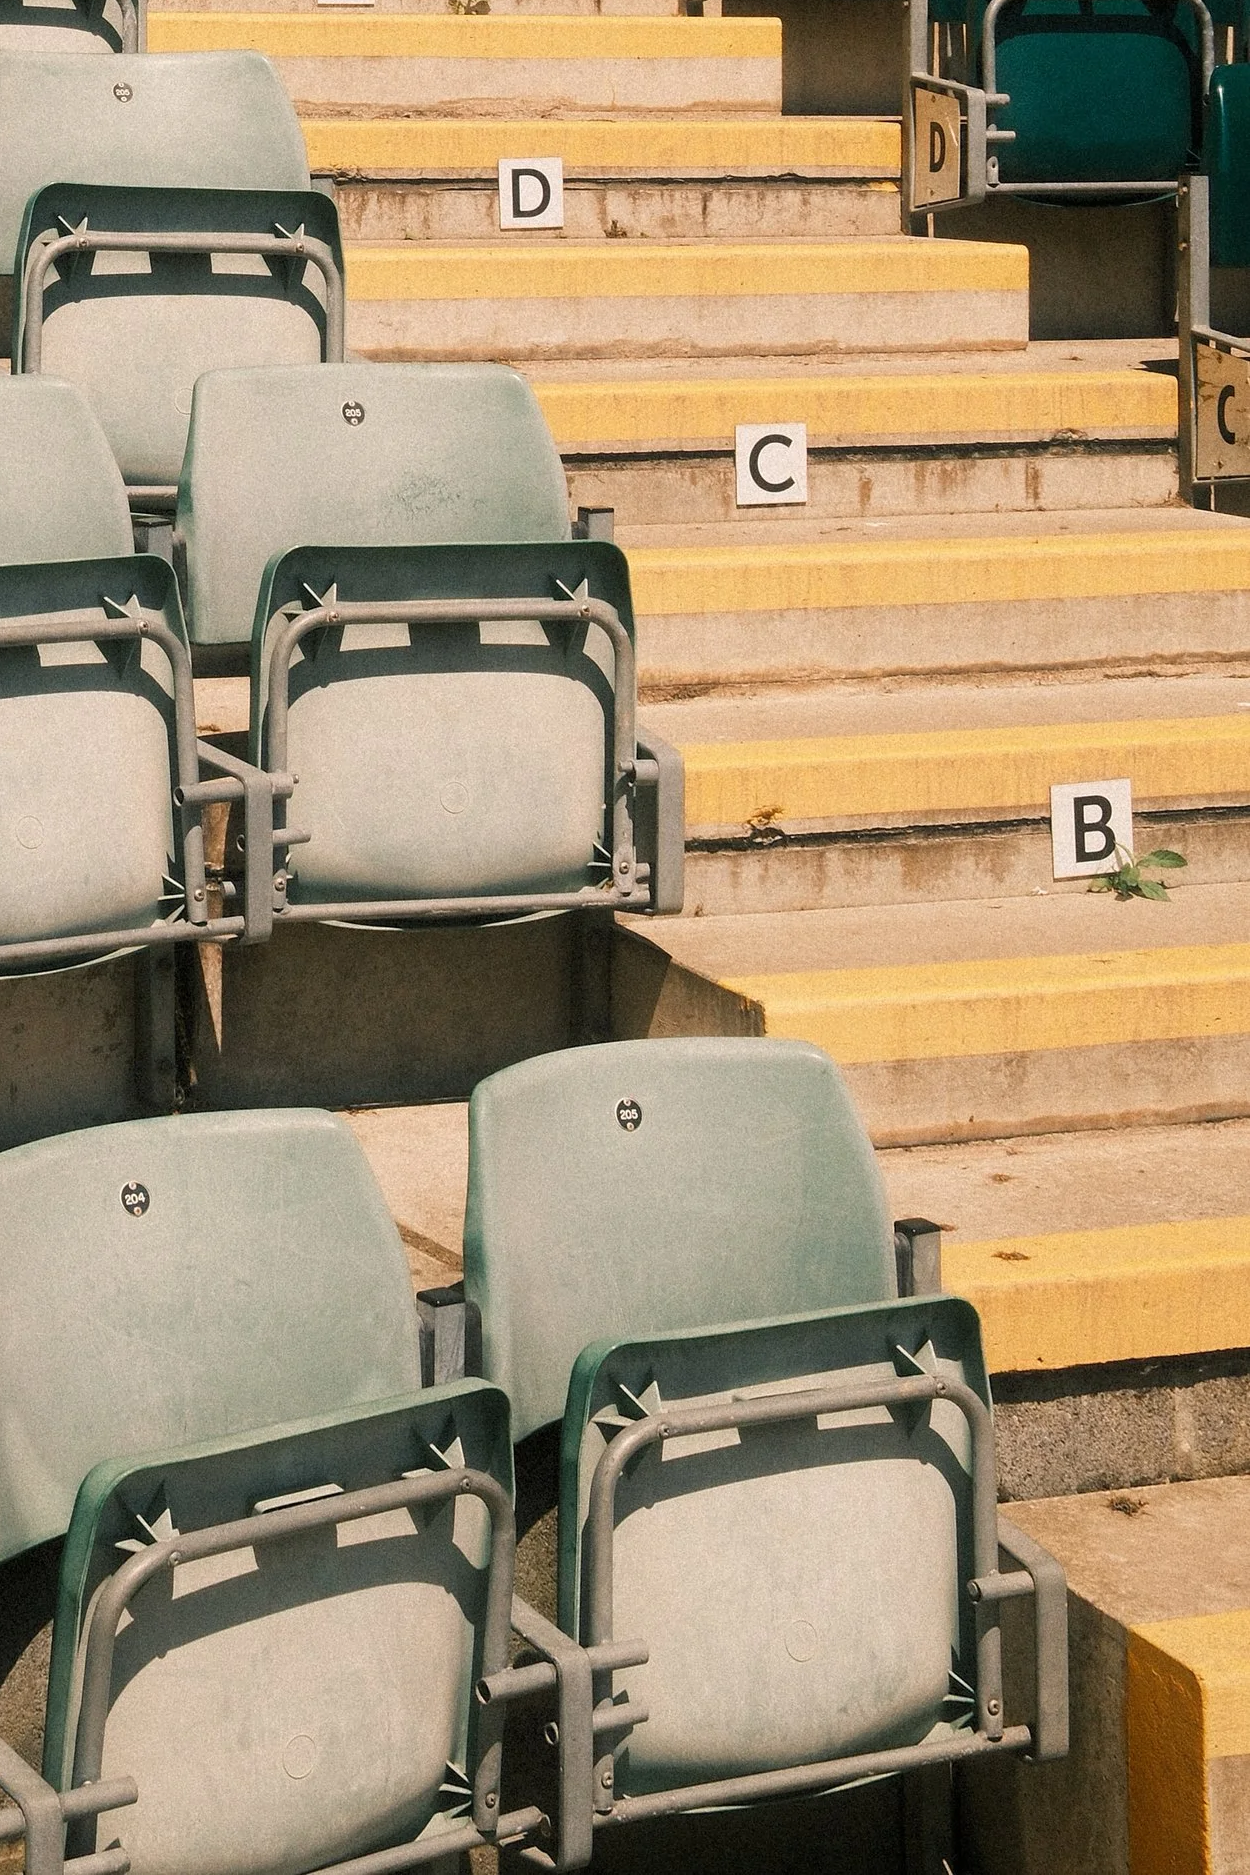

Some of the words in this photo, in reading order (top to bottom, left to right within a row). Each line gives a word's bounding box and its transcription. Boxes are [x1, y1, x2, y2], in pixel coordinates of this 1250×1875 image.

[930, 121, 946, 173] D
[511, 168, 551, 218] D
[344, 408, 362, 417] 205
[1217, 384, 1236, 445] C
[749, 434, 795, 493] C
[1073, 795, 1116, 864] B
[619, 1109, 639, 1120] 205
[124, 1192, 146, 1206] 204
